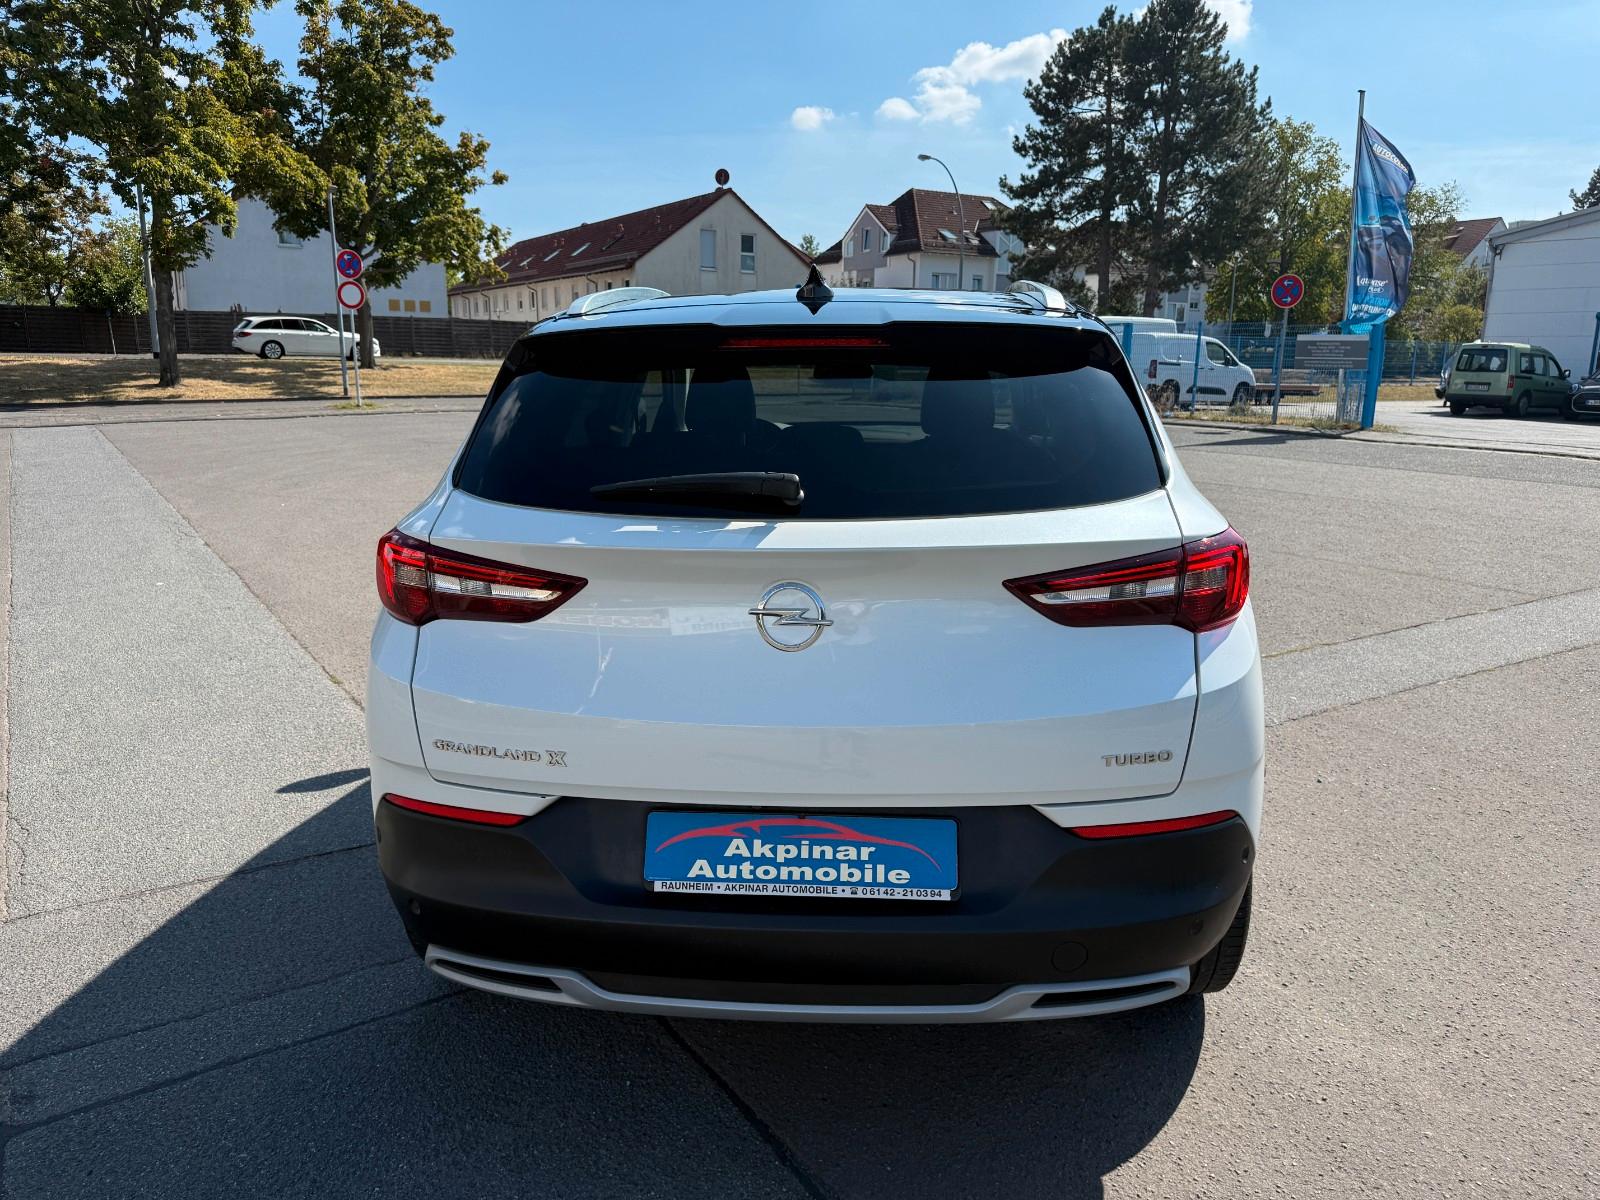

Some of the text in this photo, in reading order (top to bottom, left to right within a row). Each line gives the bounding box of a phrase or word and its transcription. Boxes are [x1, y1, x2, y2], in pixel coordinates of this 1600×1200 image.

[432, 738, 568, 768] GRANDLAND X
[1101, 749, 1173, 768] TURBO
[723, 838, 876, 863] Akpinar
[686, 859, 911, 884] Automobile
[661, 881, 714, 892] RAUNHEIM
[723, 883, 769, 893] AKPINAR
[771, 885, 838, 895] AUTOMOBILE
